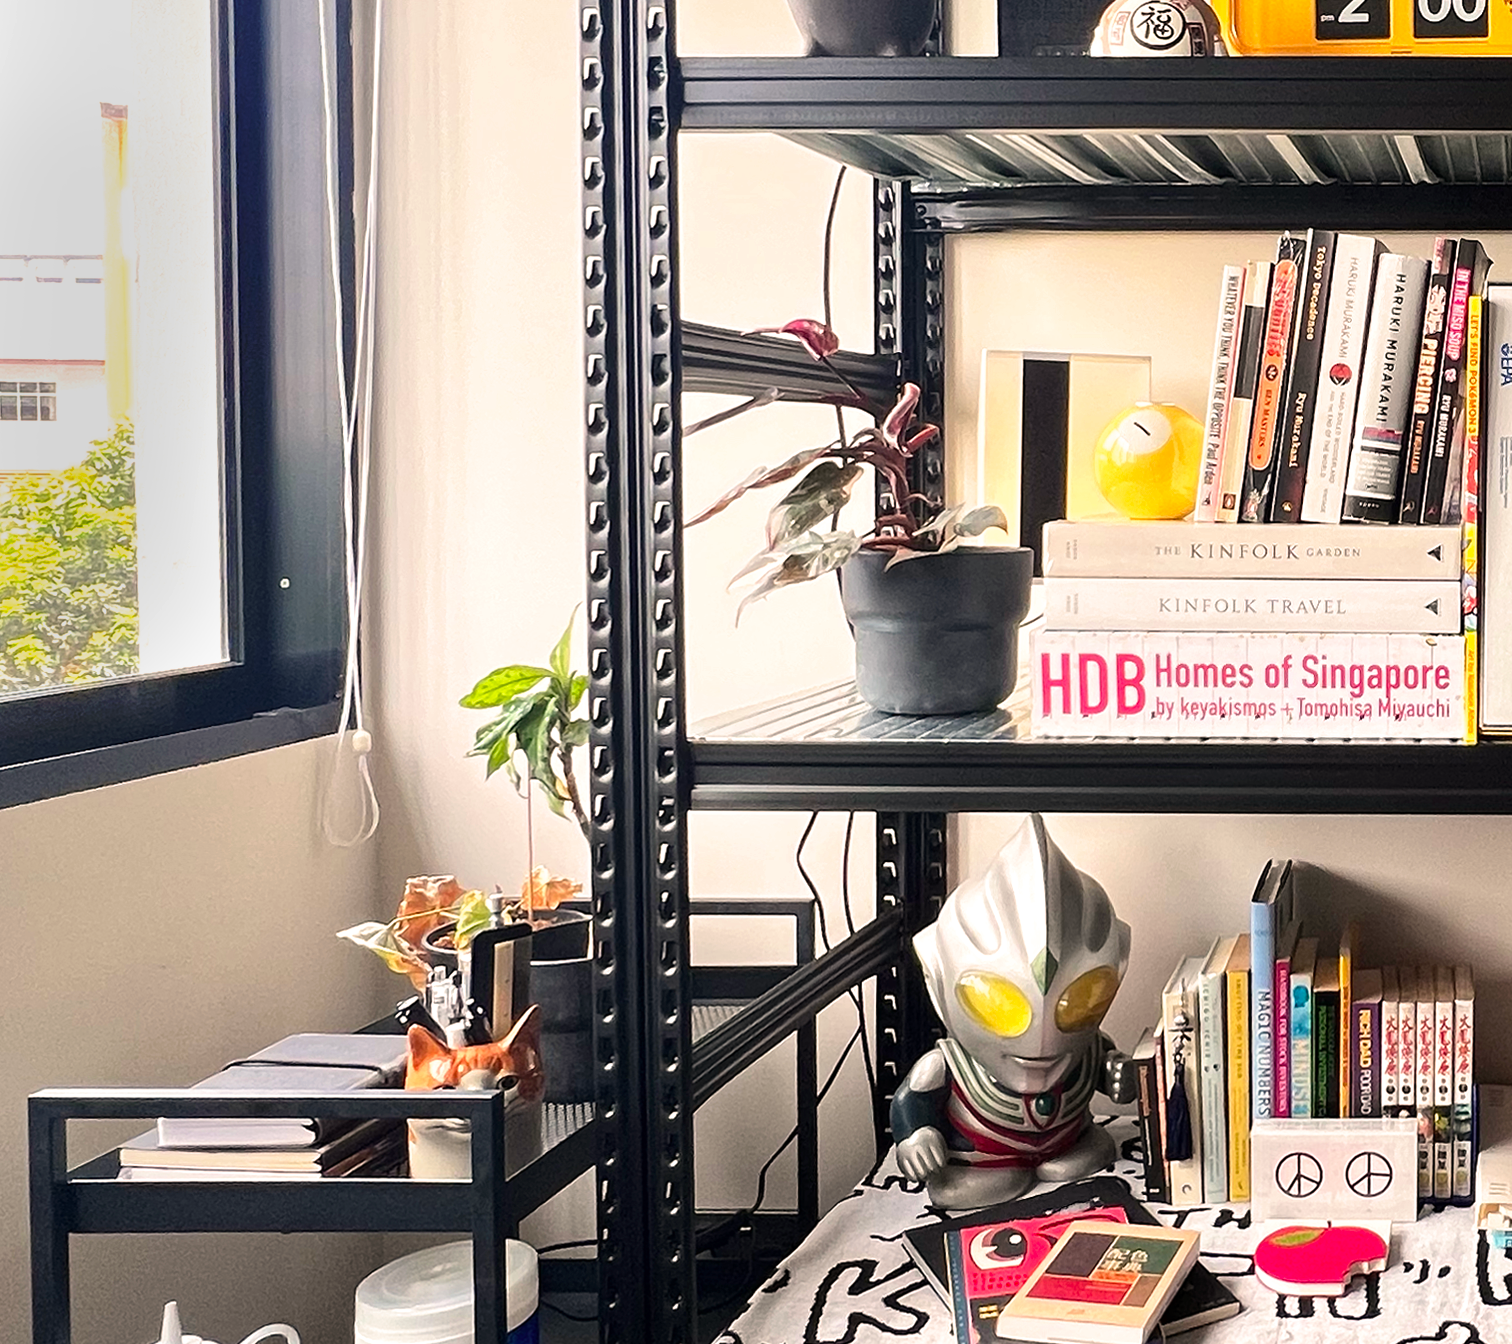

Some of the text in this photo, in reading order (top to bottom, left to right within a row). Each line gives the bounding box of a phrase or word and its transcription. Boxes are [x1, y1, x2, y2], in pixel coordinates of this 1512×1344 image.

[1136, 6, 1175, 40] 福
[1224, 275, 1239, 315] WHATEVER
[1306, 246, 1327, 341] Tokyo Decadence
[1338, 257, 1359, 359] HARUKI MURAKAMI
[1222, 317, 1234, 333] YOU
[1446, 269, 1470, 360] IN THE MISO SOUP
[1376, 273, 1407, 423] HARUKI MURAKAMI
[1216, 362, 1228, 384] THINK
[1414, 339, 1438, 414] PIERCING
[1215, 386, 1225, 401] THE
[1210, 403, 1223, 438] OPPOSITE
[1258, 389, 1272, 448] BEN MASTERS
[1288, 392, 1307, 468] Ryu Murakami
[1434, 395, 1452, 458] RYU MURAKAMI
[1206, 443, 1219, 460] Paul
[1203, 461, 1217, 485] Arden
[1155, 543, 1361, 560] THE KINFOLK GARDEN
[1159, 597, 1347, 615] KINFOLK TRAVEL
[1041, 652, 1451, 716] HDB Homes of Singapore
[1155, 697, 1174, 722] by
[1181, 697, 1277, 722] keyakismos
[1298, 697, 1373, 719] Tomohisa
[1379, 697, 1451, 722] Miyauchi
[1359, 1009, 1372, 1038] RICH
[1257, 991, 1271, 1116] MAGIC NUMBERS
[1359, 1039, 1372, 1068] DAD
[1361, 1069, 1371, 1095] POOR
